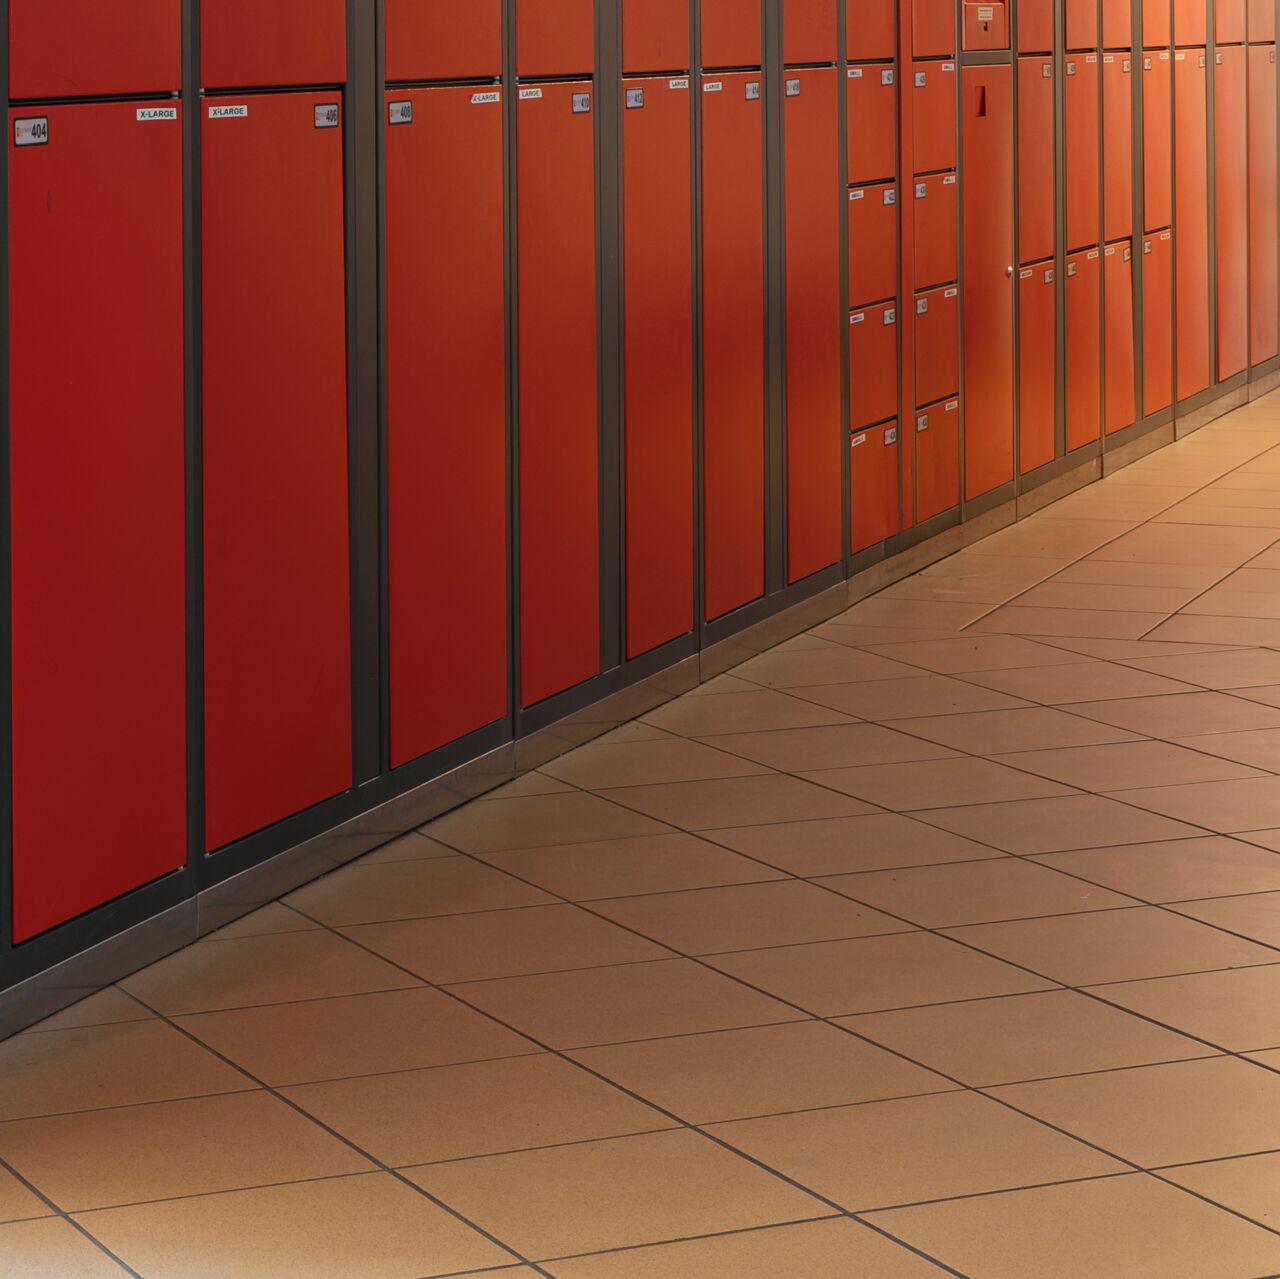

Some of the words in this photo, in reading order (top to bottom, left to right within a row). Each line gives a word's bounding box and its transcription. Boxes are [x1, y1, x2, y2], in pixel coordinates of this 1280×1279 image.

[521, 90, 540, 98] LARGE
[140, 110, 175, 118] X-LARGE
[212, 107, 244, 116] X-LARGE
[325, 109, 337, 123] 406
[400, 105, 411, 120] 408
[31, 123, 47, 138] 404
